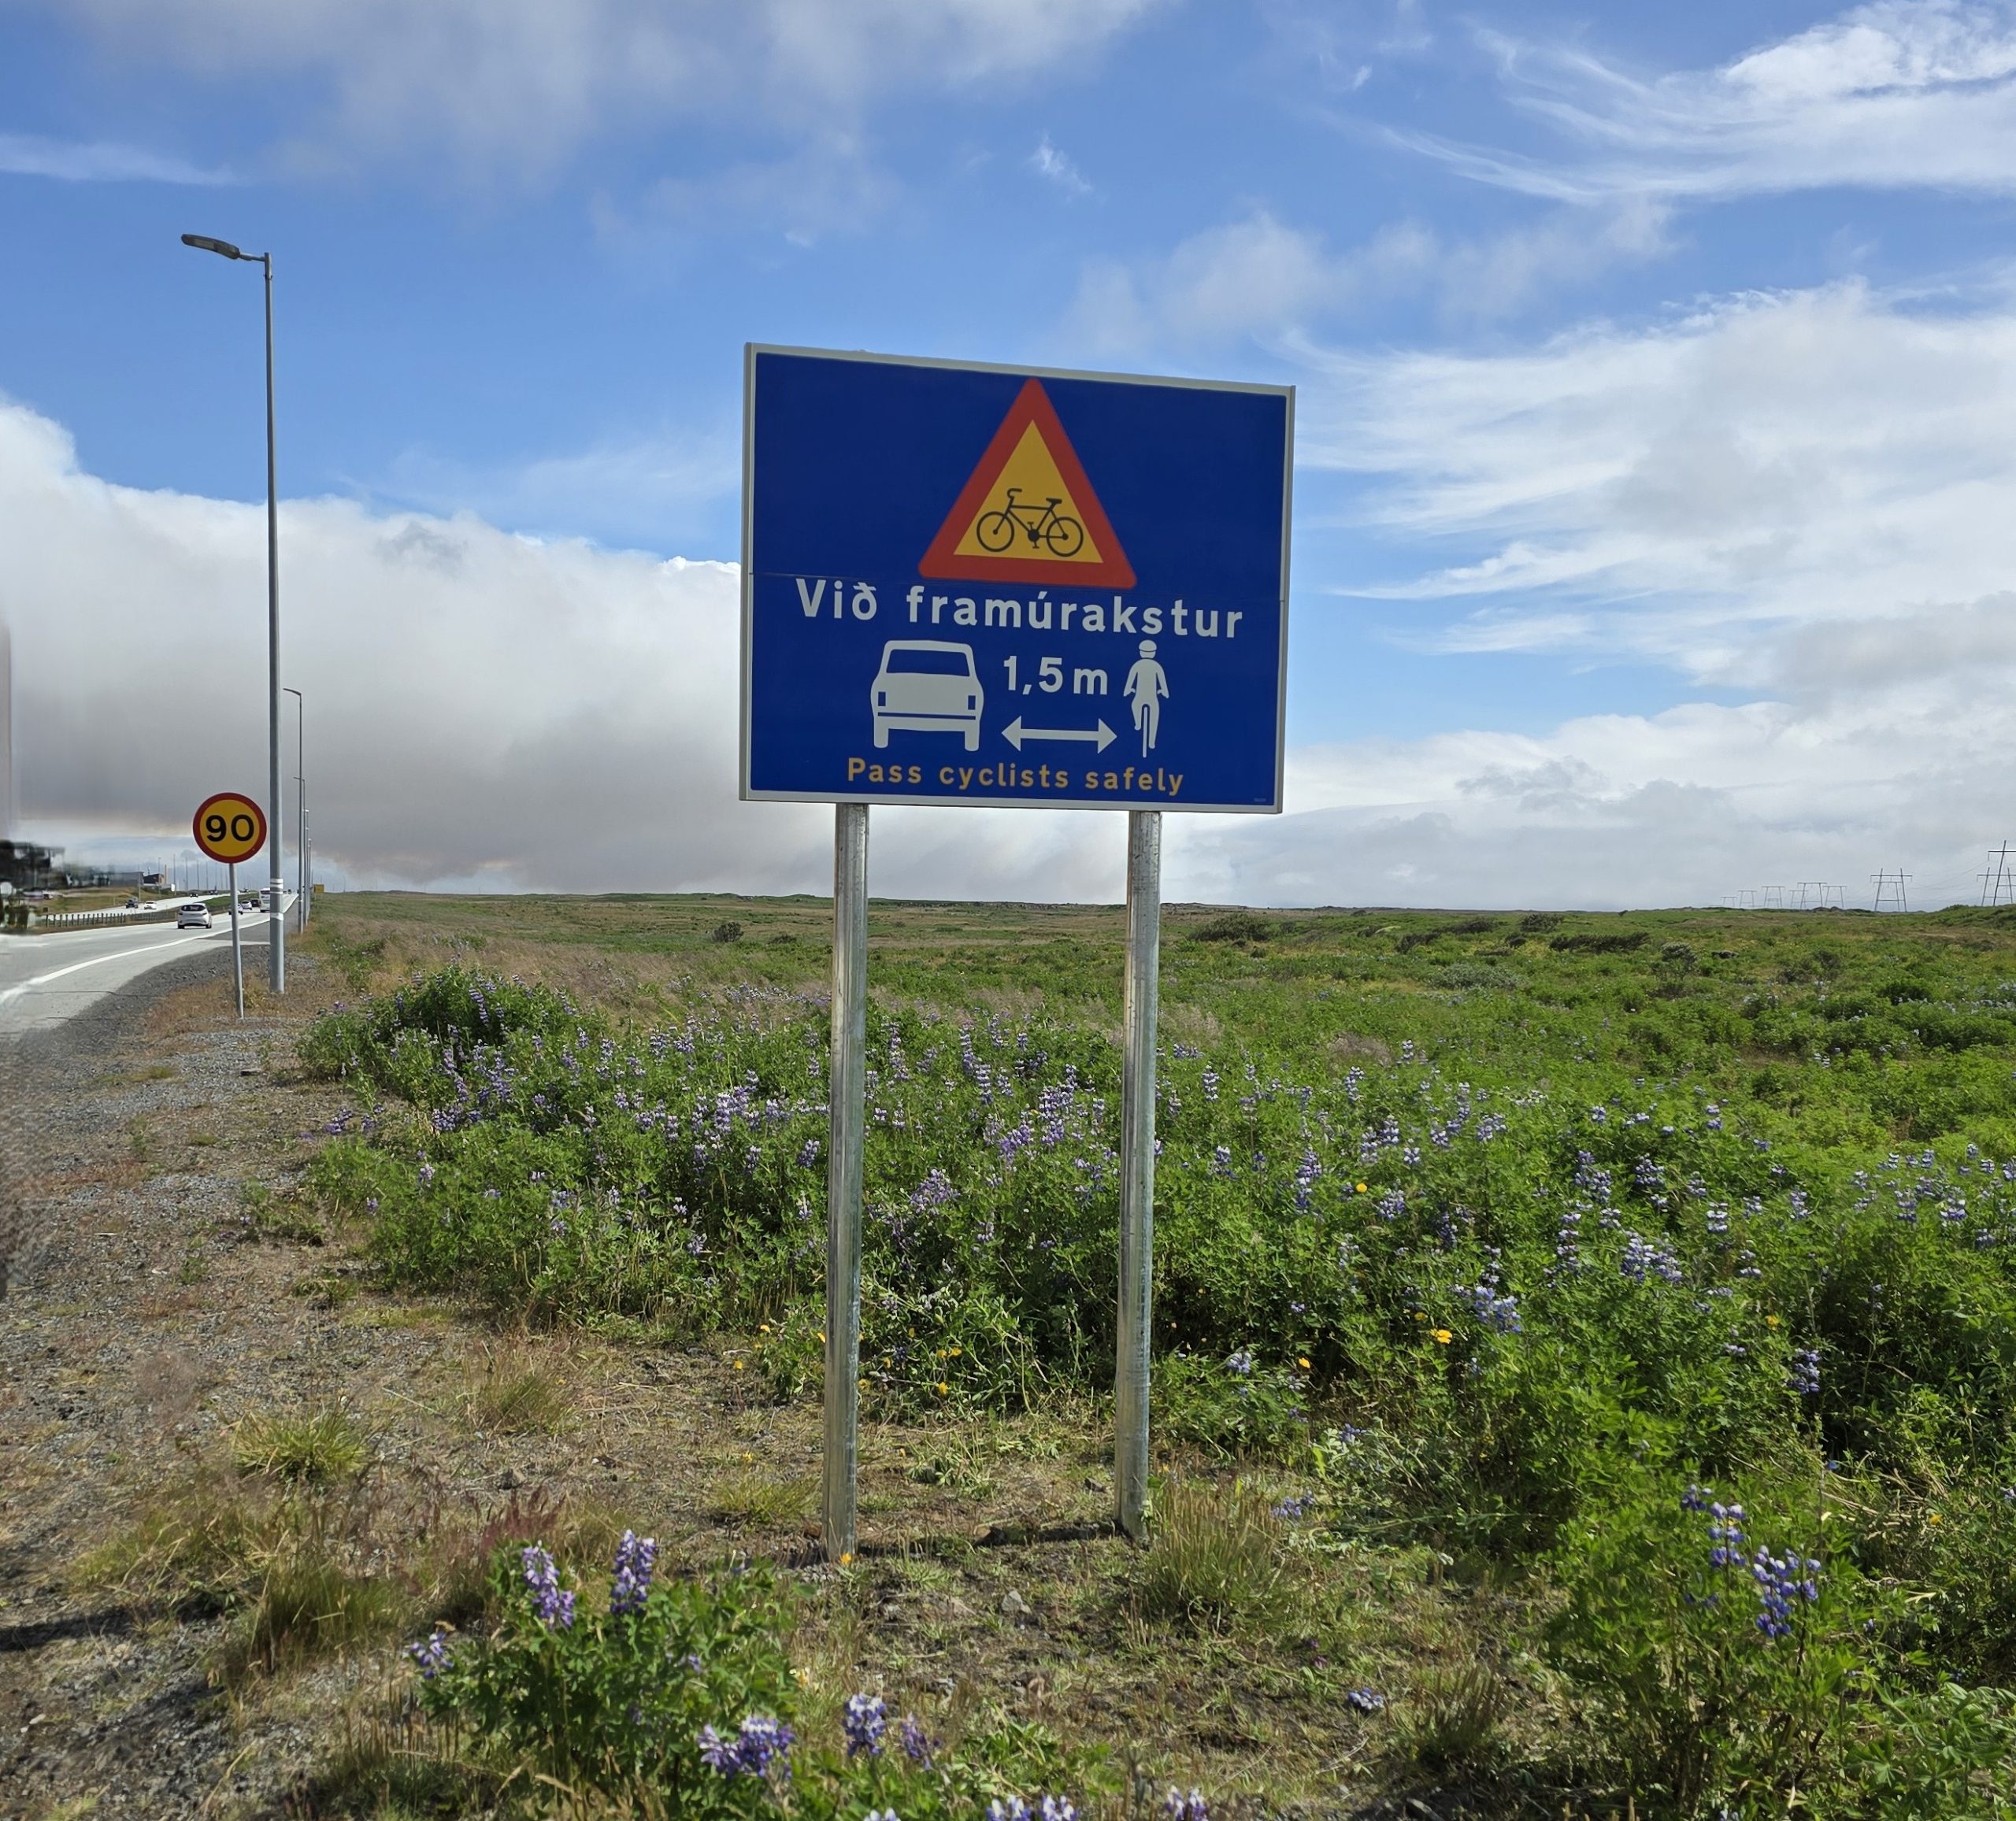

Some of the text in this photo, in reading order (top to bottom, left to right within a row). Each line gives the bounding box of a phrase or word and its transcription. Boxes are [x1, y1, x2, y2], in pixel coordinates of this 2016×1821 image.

[795, 578, 1243, 638] Við framúrakstur
[847, 757, 1184, 796] Pass cyclists safely
[205, 814, 254, 842] 90
